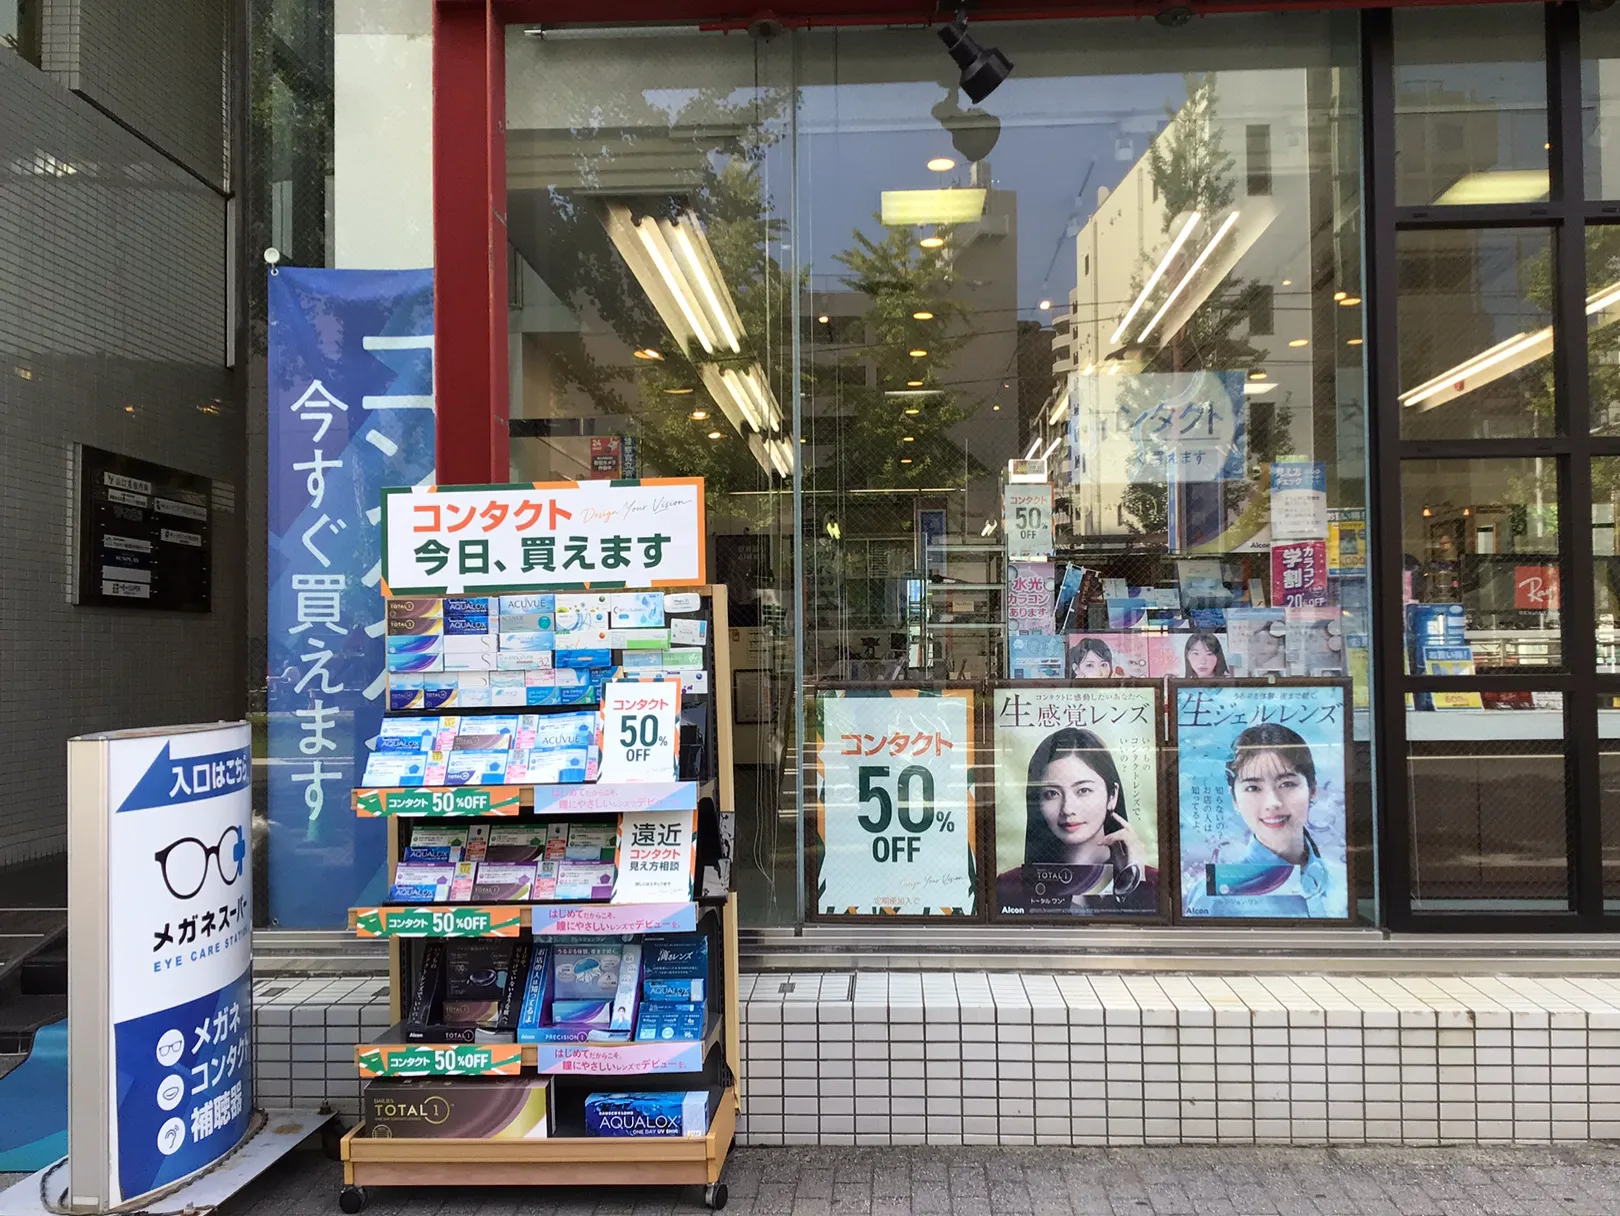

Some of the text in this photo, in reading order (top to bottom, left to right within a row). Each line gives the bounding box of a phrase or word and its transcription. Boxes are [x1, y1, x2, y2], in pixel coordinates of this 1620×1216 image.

[1010, 495, 1048, 505] コンタクト
[413, 498, 572, 533] コンタクト
[580, 496, 692, 524] Design Your Vision
[1020, 530, 1037, 540] OFF
[414, 533, 672, 576] 今日、買えます
[1282, 547, 1303, 589] 学割
[1303, 546, 1314, 588] カラコン
[1012, 577, 1042, 591] 水光
[290, 379, 349, 822] 今すぐ買えます
[508, 600, 546, 609] ACUVUE
[1008, 594, 1048, 606] カラコン
[1009, 607, 1047, 618] あります
[450, 621, 487, 629] AQUALOX
[538, 656, 550, 668] 32
[613, 699, 669, 710] コンタクト
[1000, 694, 1150, 728] 生感覚レンズ
[1178, 691, 1344, 727] 生ジェルレンズ
[841, 732, 954, 757] コンタクト
[626, 748, 651, 762] OFF
[168, 754, 247, 798] 入口はこちら
[389, 798, 428, 808] コンタクト
[1203, 786, 1213, 832] お店の人は
[631, 823, 682, 846] 遠近
[630, 849, 681, 860] コンタクト
[872, 836, 922, 863] OFF
[629, 861, 680, 871] 見え方相談
[549, 909, 616, 919] はじめてだからこそ、
[1001, 906, 1025, 914] Alcon
[1186, 907, 1209, 915] Alcon
[153, 895, 247, 952] メガネスーパー
[389, 919, 428, 928] コンタクト
[154, 956, 182, 972] EYE
[190, 942, 220, 961] CARE
[650, 987, 690, 995] AQUALOX
[191, 1001, 240, 1054] メガネ
[554, 1049, 622, 1059] はじめてだからこそ、
[191, 1032, 249, 1095] コンタクト
[391, 1057, 430, 1067] コンタクト
[191, 1080, 243, 1143] 補聴器
[375, 1104, 428, 1116] TOTAL
[600, 1115, 678, 1129] AQUALOX
